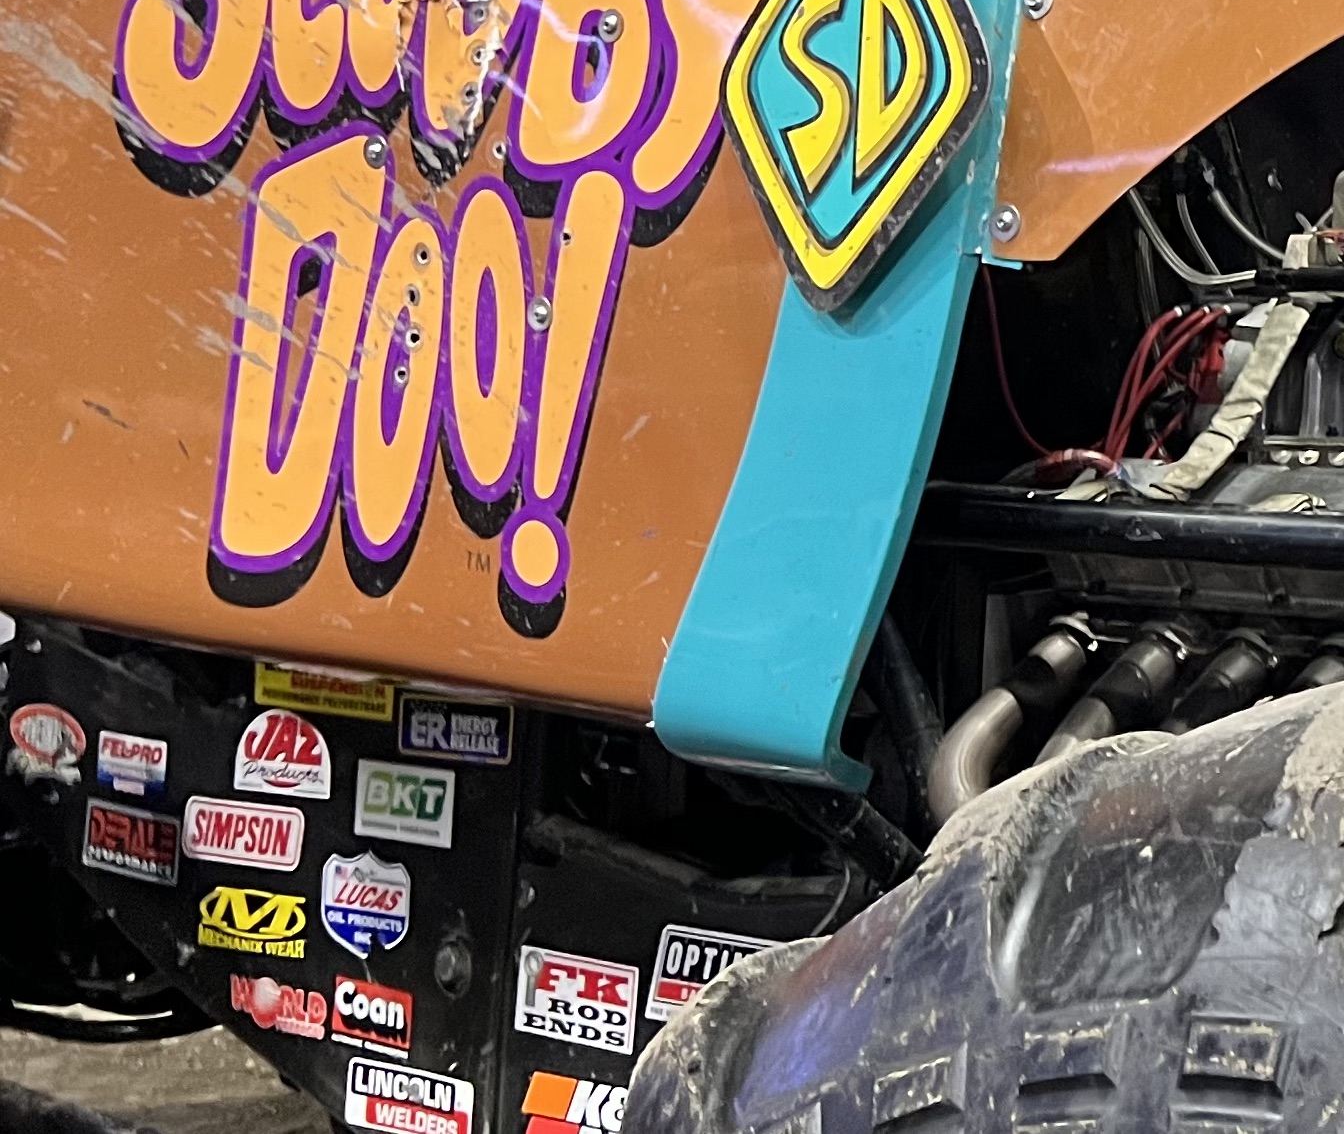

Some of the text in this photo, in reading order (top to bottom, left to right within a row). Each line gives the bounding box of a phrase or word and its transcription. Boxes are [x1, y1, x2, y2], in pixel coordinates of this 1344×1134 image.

[244, 713, 322, 767] JAZ
[410, 712, 449, 750] ER
[242, 760, 325, 784] Products
[367, 777, 444, 814] BKT
[192, 809, 292, 857] SIMPSON
[333, 882, 403, 912] LUCAS
[327, 910, 403, 933] OIL PRODUCTS
[198, 923, 307, 959] MECHANIX WEAR
[230, 973, 328, 1030] WORLD
[535, 960, 629, 1008] FK
[335, 980, 404, 1030] Coan
[548, 997, 628, 1027] ROD
[523, 1012, 626, 1047] ENDS
[354, 1065, 452, 1113] LINCOLN
[374, 1102, 459, 1134] WELDERS
